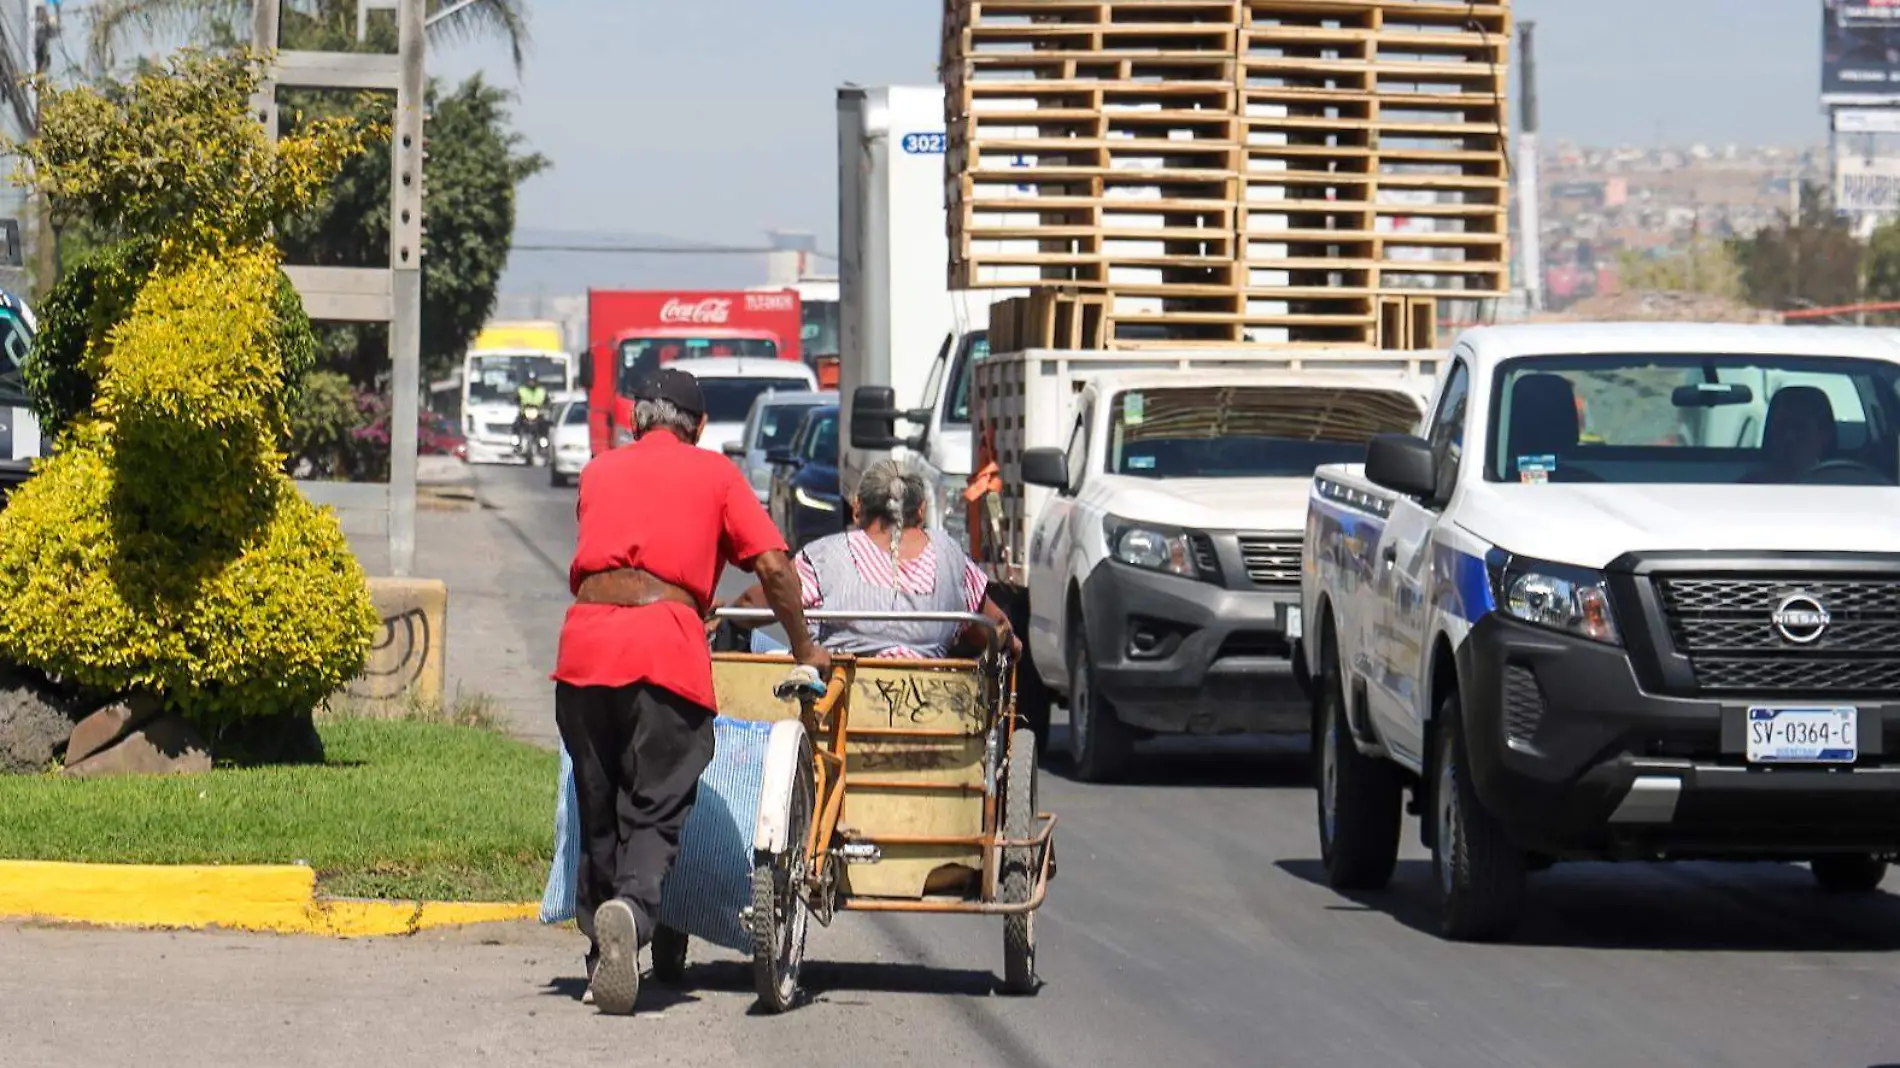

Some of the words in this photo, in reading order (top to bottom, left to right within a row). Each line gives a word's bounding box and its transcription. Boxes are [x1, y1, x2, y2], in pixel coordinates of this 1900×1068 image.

[907, 134, 946, 151] 302
[1772, 612, 1830, 625] NISSAN
[1753, 721, 1851, 745] SV-0364-C
